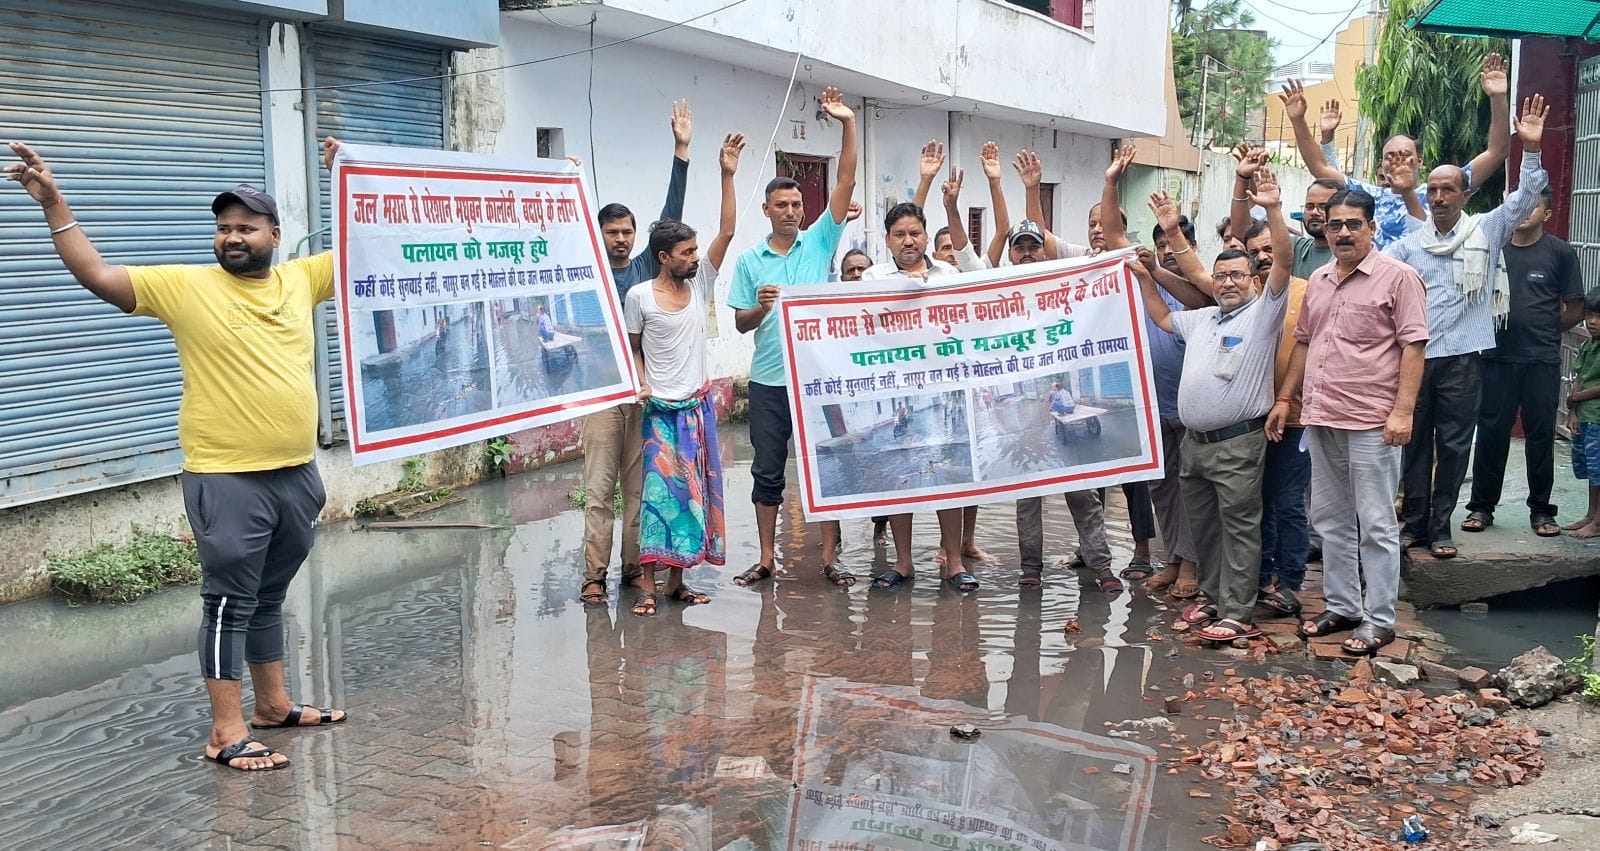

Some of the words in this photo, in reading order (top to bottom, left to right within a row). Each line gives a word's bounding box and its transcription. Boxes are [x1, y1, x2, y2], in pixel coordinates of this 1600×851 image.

[352, 194, 378, 224] जल
[409, 186, 421, 224] से
[421, 187, 453, 224] परेशान
[484, 190, 520, 229] कालोनी,
[545, 191, 555, 222] के
[556, 192, 579, 222] लोग
[401, 243, 458, 262] पलायन
[462, 237, 482, 260] को
[486, 241, 525, 264] मजबूर
[529, 236, 548, 263] हुये
[354, 274, 376, 297] कहीं
[379, 273, 395, 298] कोई
[507, 267, 517, 286] की
[526, 270, 537, 285] जल
[554, 264, 565, 283] की
[566, 265, 594, 281] समस्या
[794, 318, 822, 342] जल
[826, 316, 859, 338] भराव
[861, 309, 876, 335] से
[879, 307, 923, 333] परेशान
[972, 291, 1031, 321] कालोनी,
[1074, 278, 1089, 302] के
[1092, 270, 1121, 298] लोग
[850, 344, 927, 366] पलायन
[933, 337, 964, 357] को
[972, 329, 1036, 352] मजबूर
[1043, 318, 1073, 346] हुये
[804, 378, 822, 397] कहीं
[824, 375, 843, 396] कोई
[845, 372, 876, 397] सुनवाई
[902, 371, 926, 389] नासूर
[929, 369, 943, 382] बन
[961, 362, 970, 379] है
[972, 358, 1004, 378] मोहल्ले
[1006, 354, 1020, 373] की
[1022, 356, 1035, 369] यह
[1038, 352, 1054, 367] जल
[1080, 340, 1095, 357] की
[1097, 336, 1129, 355] समस्या
